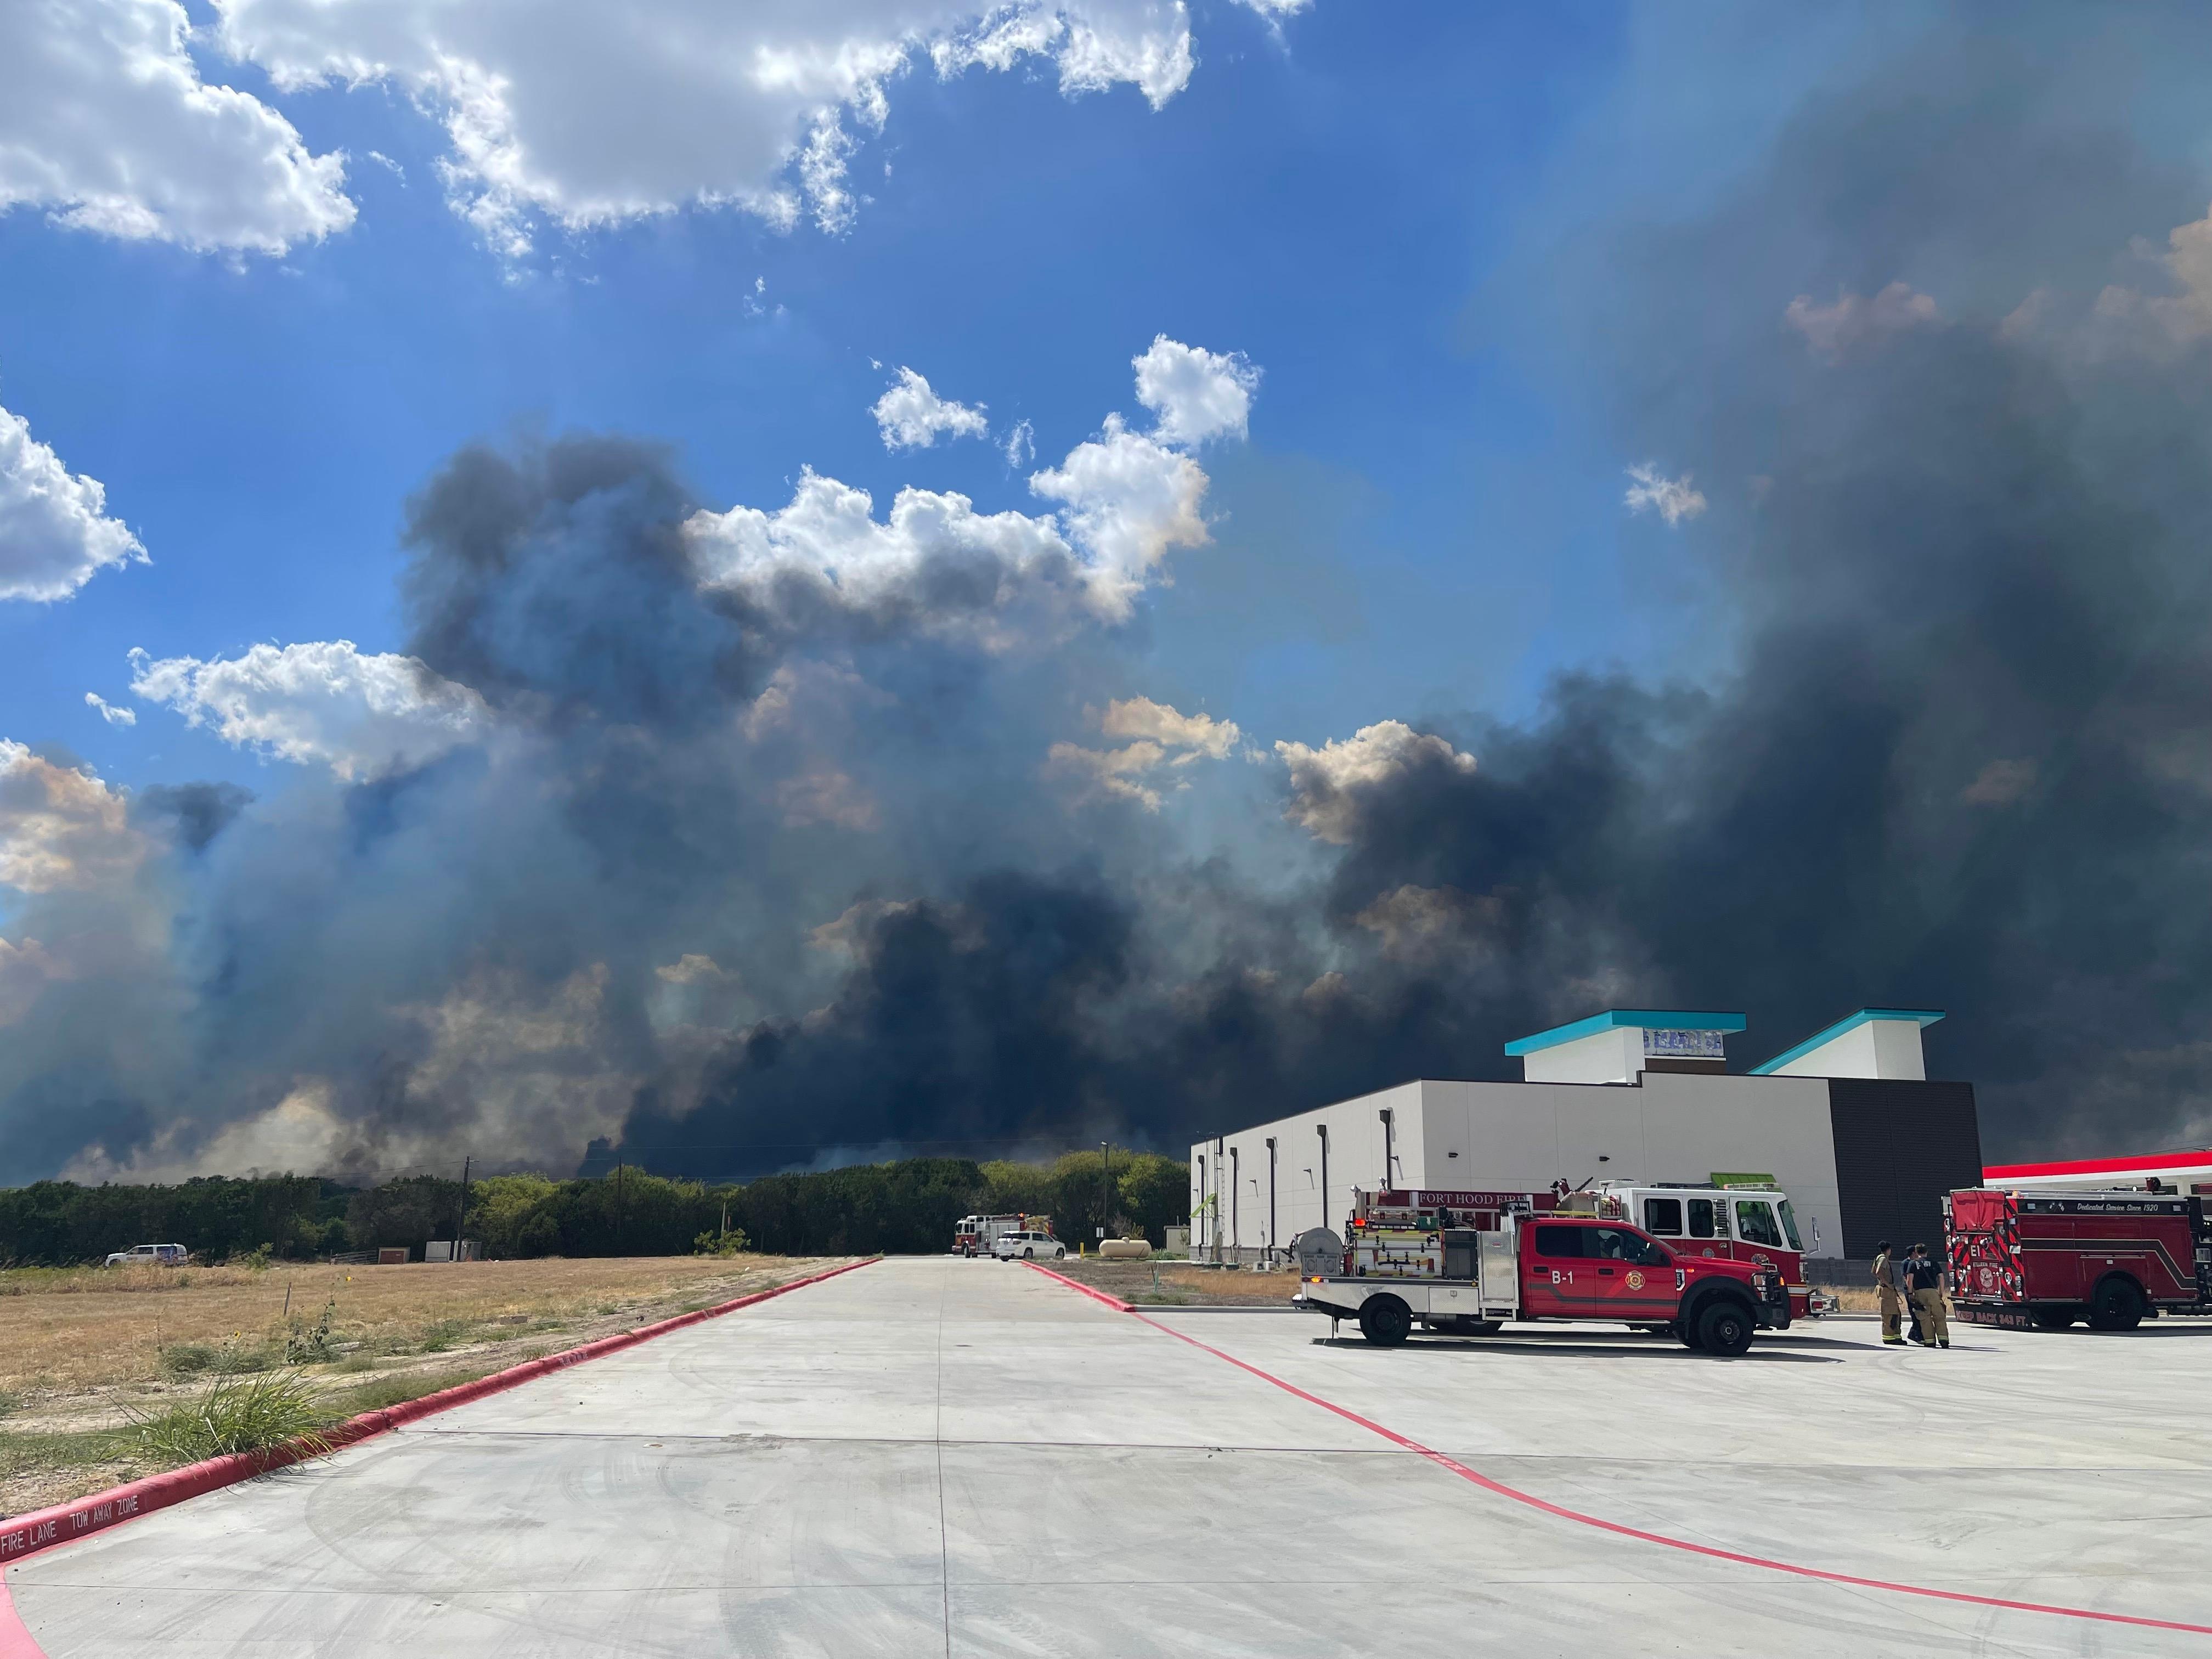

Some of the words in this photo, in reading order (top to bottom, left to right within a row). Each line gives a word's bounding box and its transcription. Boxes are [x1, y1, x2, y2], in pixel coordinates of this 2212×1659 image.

[1419, 1193, 1453, 1203] FORT
[1455, 1194, 1493, 1204] HOOD
[2106, 1203, 2125, 1211] Service
[1971, 1245, 1980, 1257] E1
[1551, 1270, 1573, 1284] B-1
[1955, 1310, 1974, 1321] KEEP
[1976, 1312, 1997, 1323] BACK
[1999, 1314, 2014, 1325] 343
[2016, 1316, 2028, 1327] FT.
[1, 1530, 25, 1554] FIRE
[30, 1520, 58, 1546] LANE
[69, 1509, 88, 1531] TOW
[93, 1502, 112, 1523] AWAY
[117, 1495, 139, 1516] ZONE
